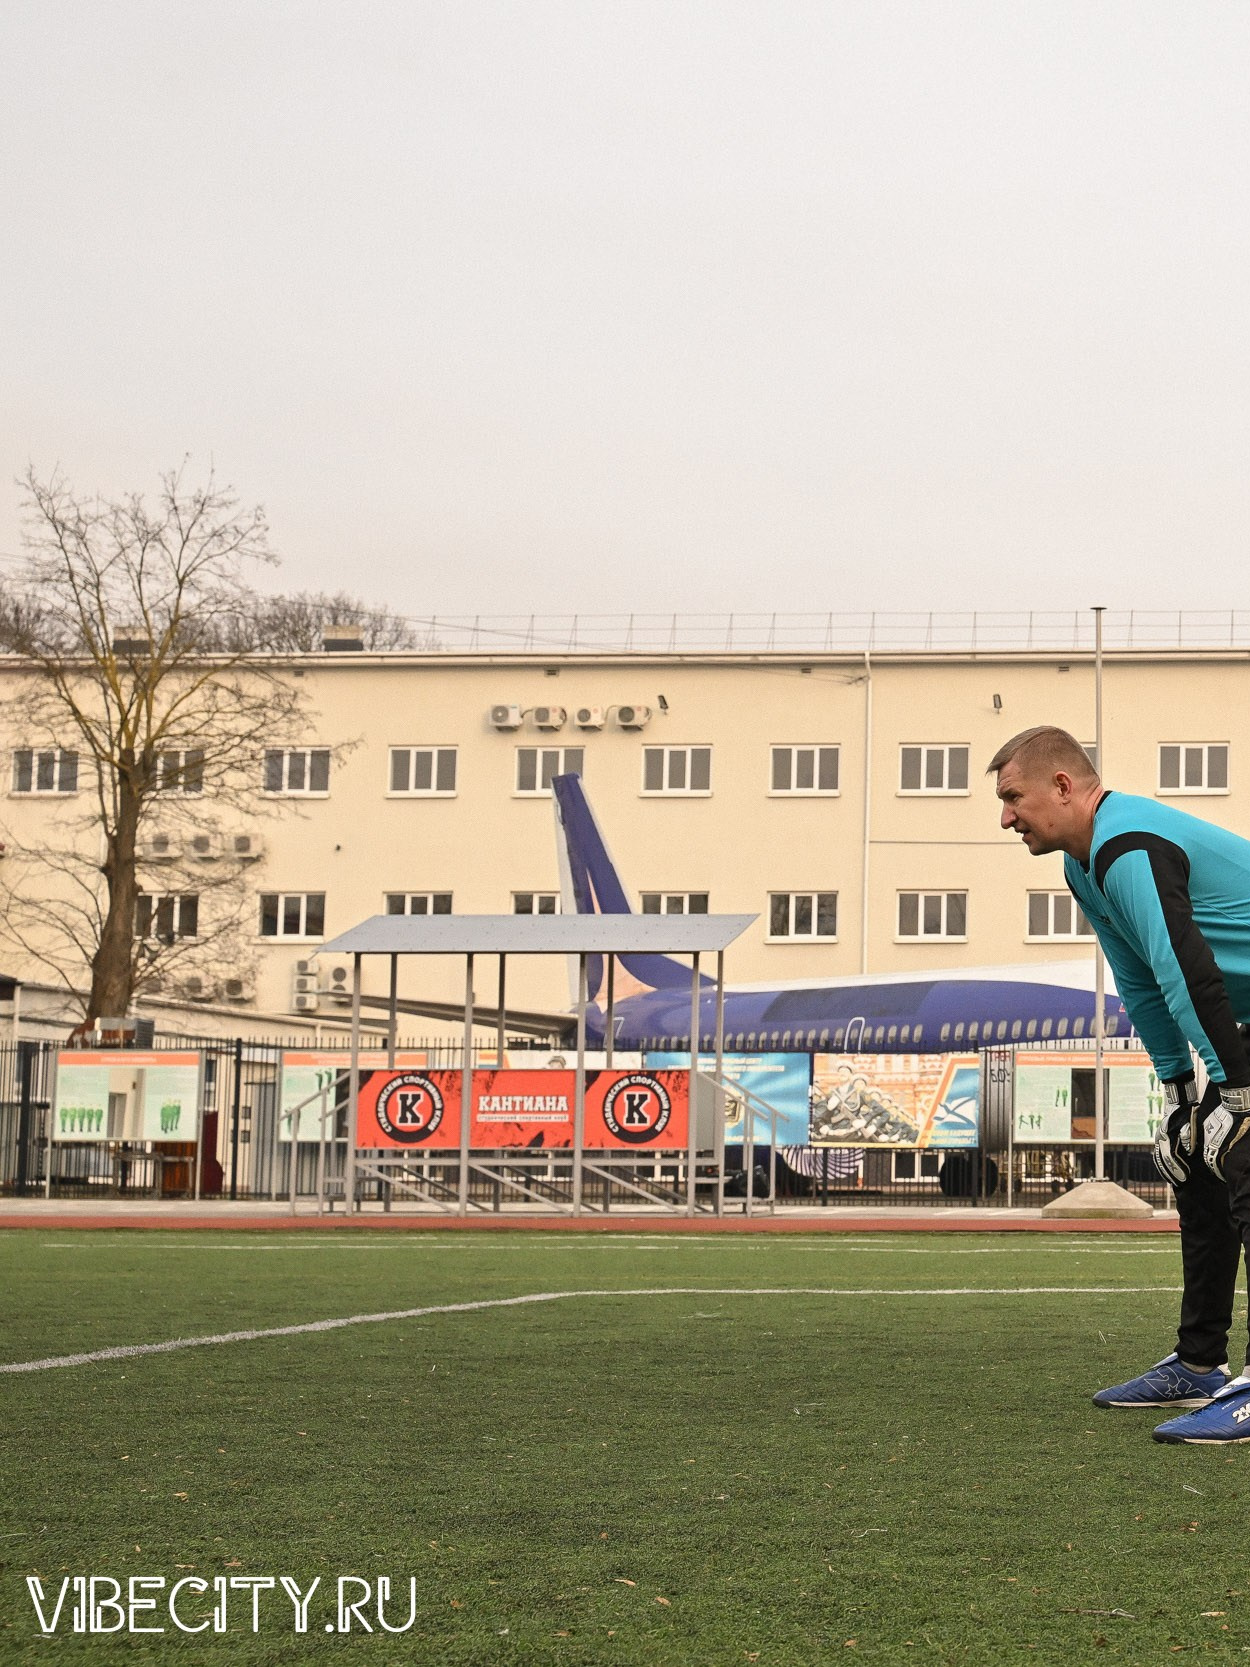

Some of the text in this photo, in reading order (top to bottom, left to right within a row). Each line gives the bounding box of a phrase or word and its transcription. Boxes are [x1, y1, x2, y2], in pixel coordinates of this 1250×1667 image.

[478, 1095, 569, 1112] КАНТИАНА
[630, 1075, 671, 1110] СПОРТИВНЫЙ
[654, 1110, 670, 1132] КЛУБ
